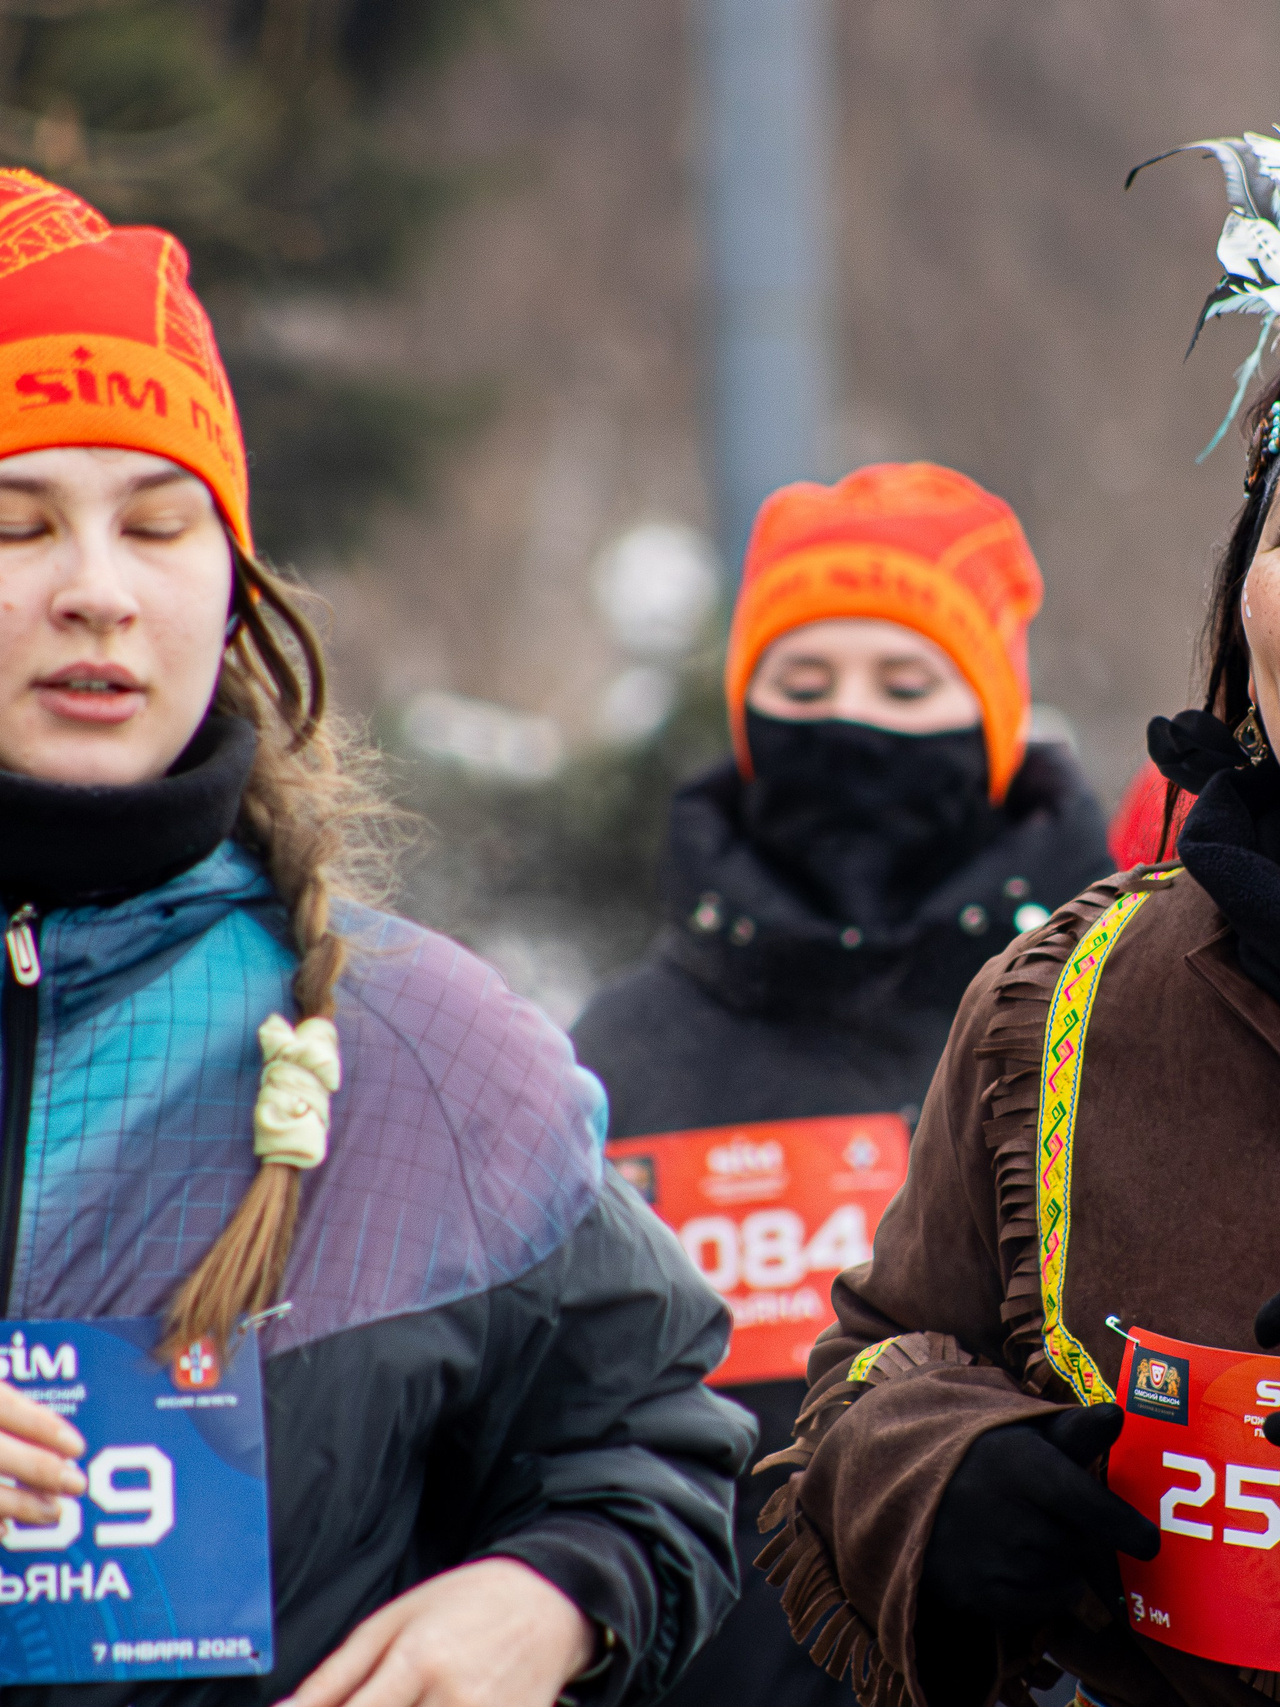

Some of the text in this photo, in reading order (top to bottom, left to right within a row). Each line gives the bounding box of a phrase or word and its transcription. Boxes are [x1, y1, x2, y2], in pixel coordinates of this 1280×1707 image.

[1130, 1592, 1145, 1618] 3
[92, 1640, 107, 1663] 7
[197, 1637, 252, 1659] 2025
